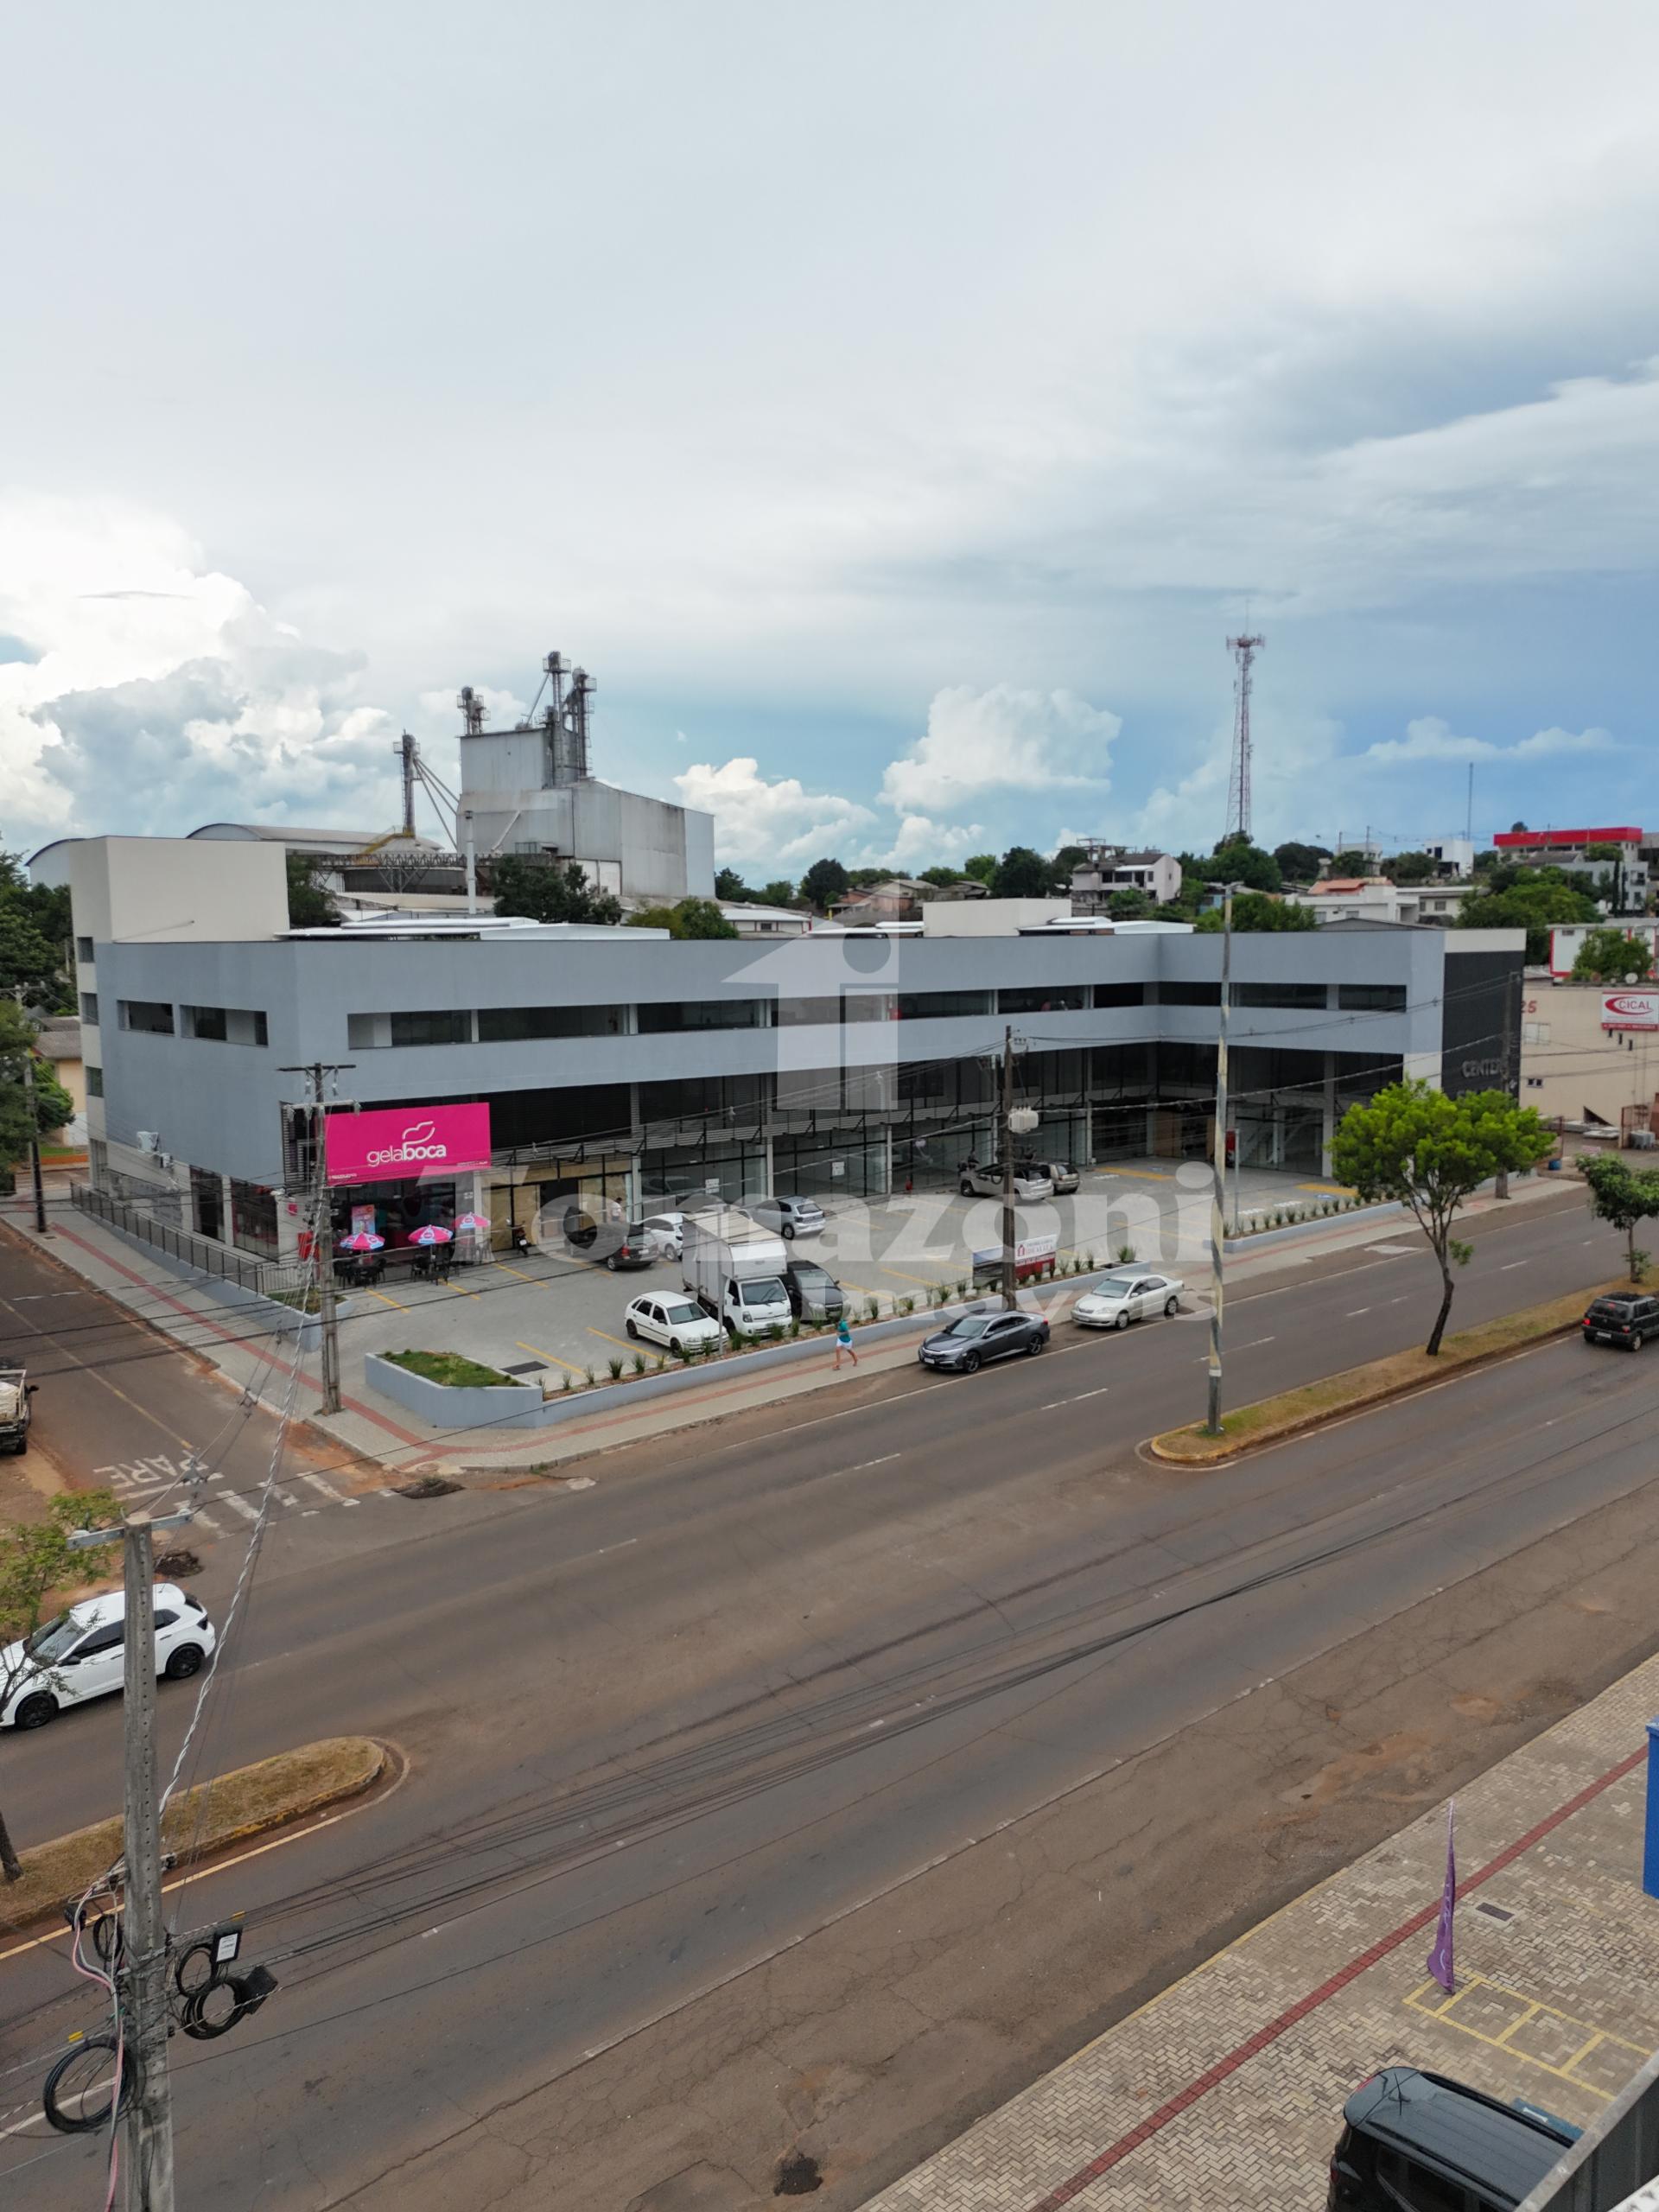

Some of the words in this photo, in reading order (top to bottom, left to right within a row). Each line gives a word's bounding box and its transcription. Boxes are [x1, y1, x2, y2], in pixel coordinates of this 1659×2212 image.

[1618, 1001, 1651, 1010] CICAL
[366, 1142, 447, 1167] gelaboca
[92, 1450, 210, 1489] PARE
